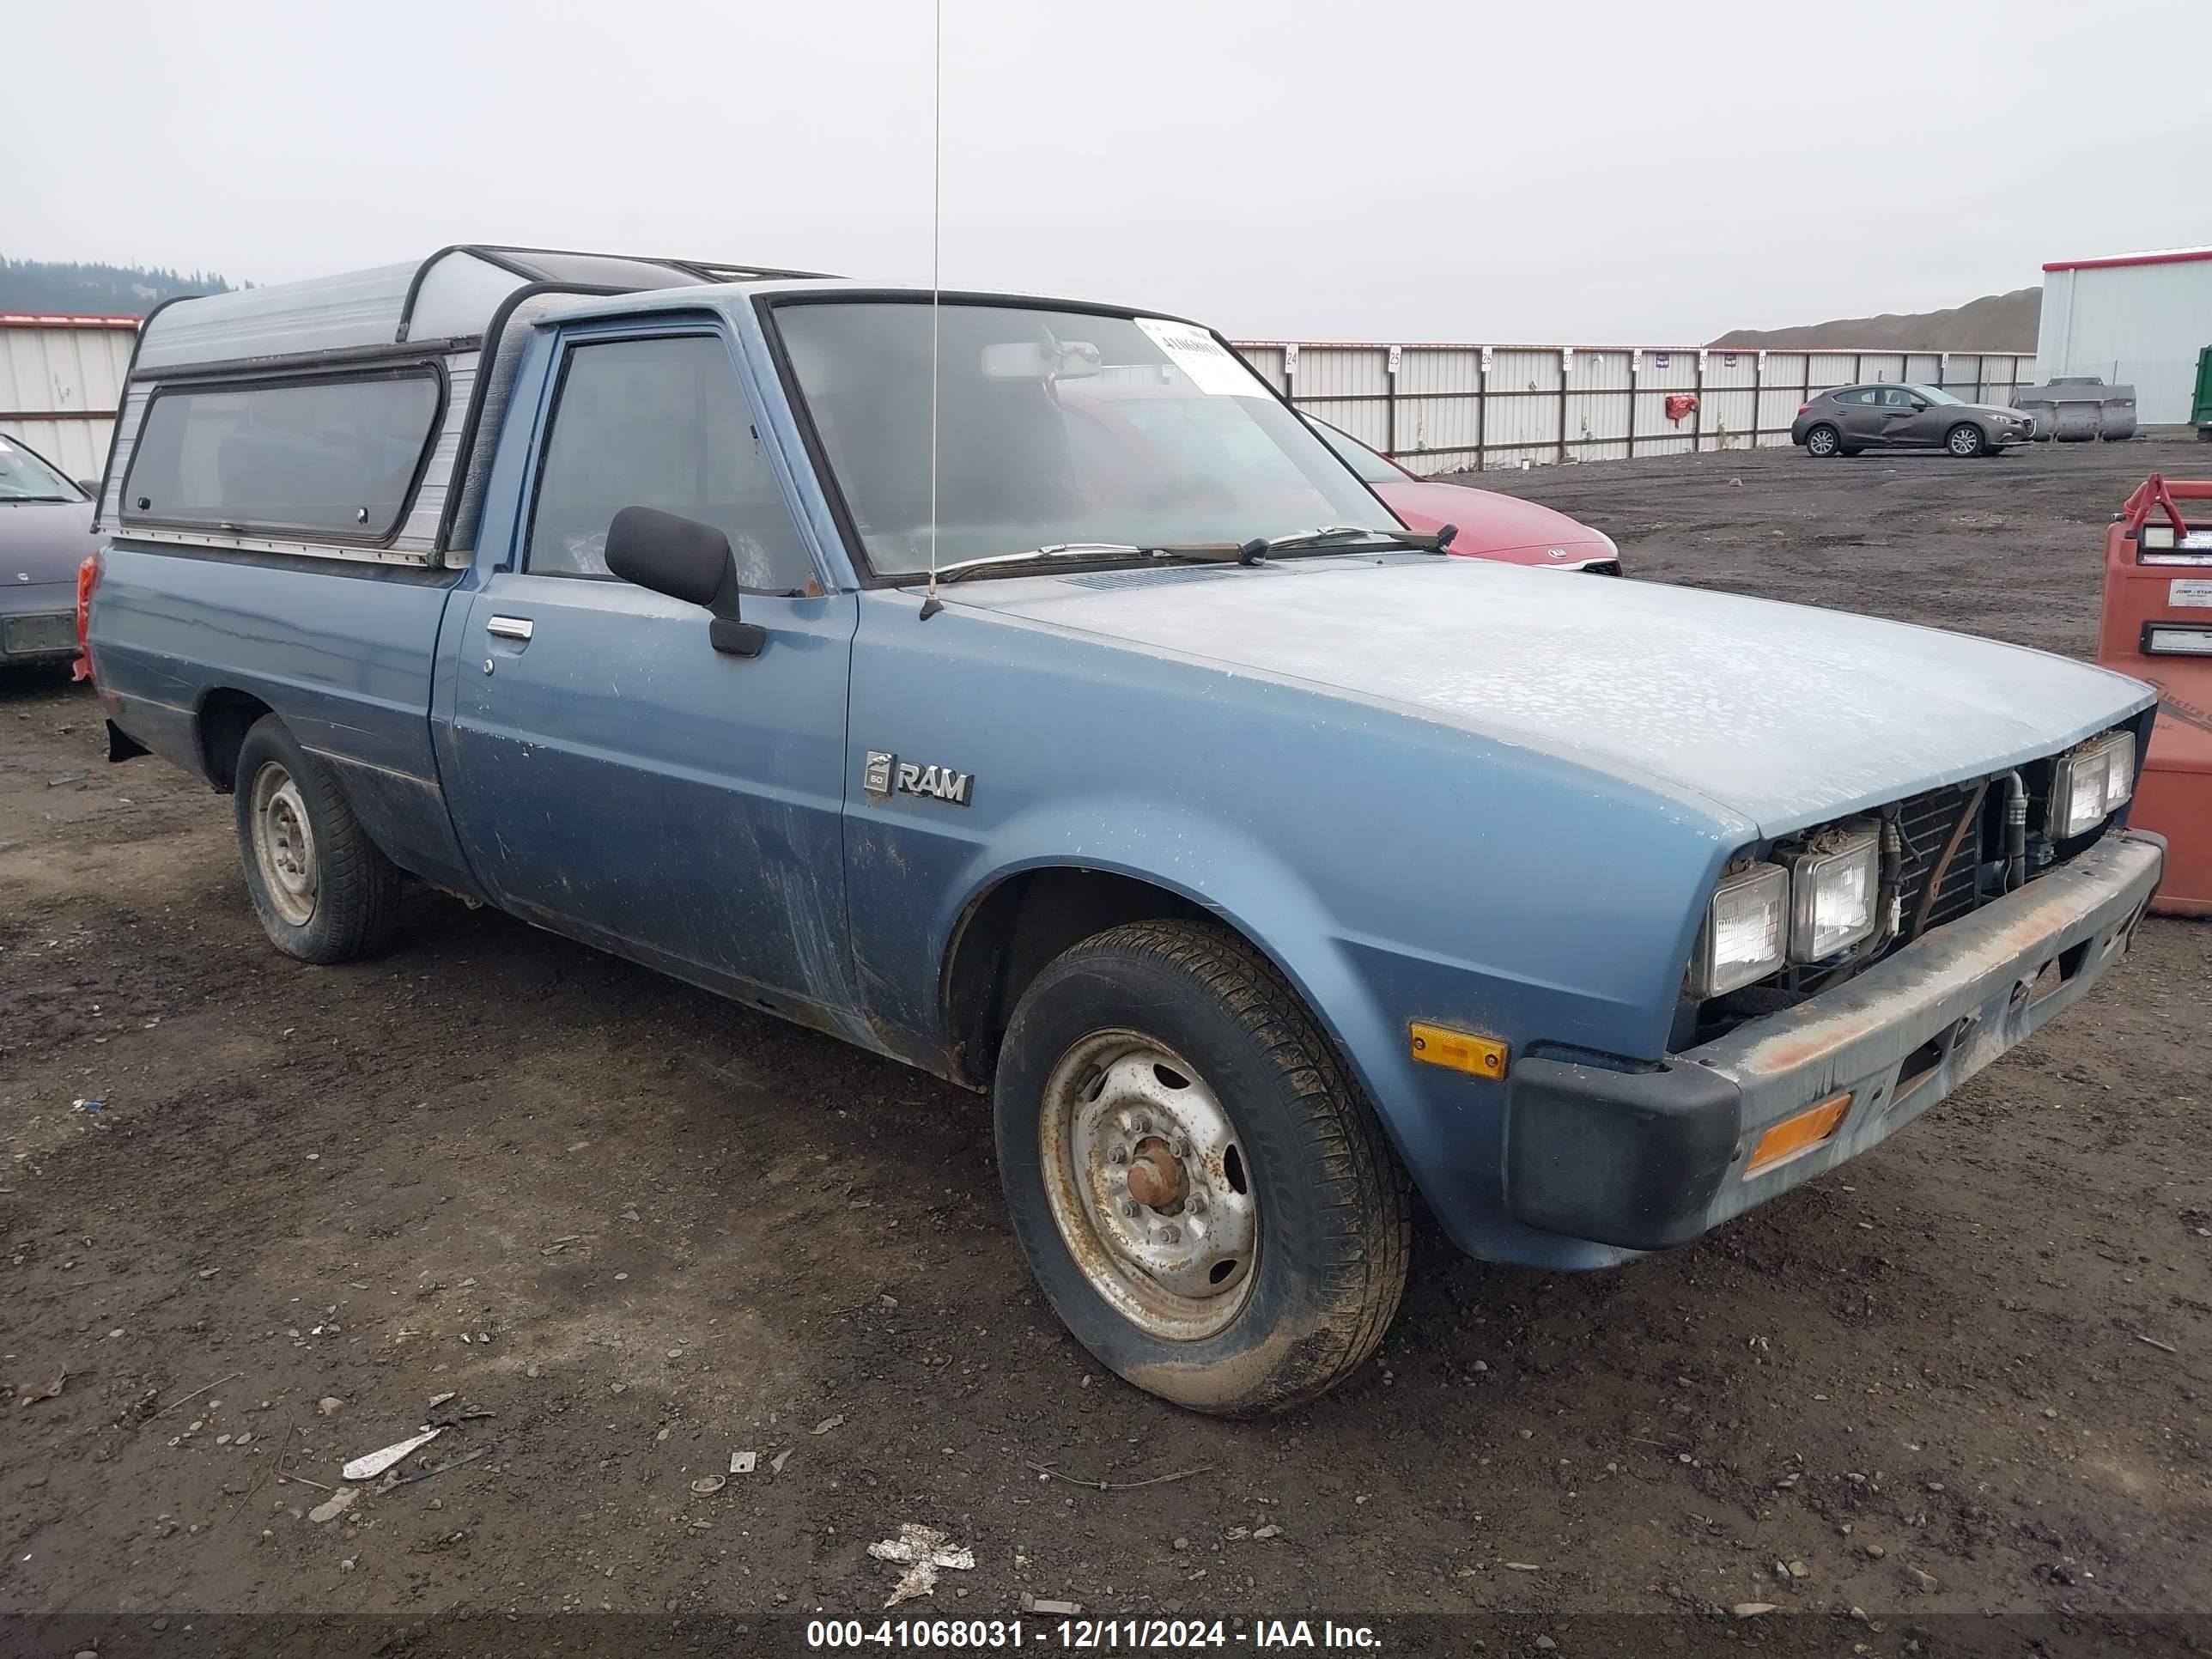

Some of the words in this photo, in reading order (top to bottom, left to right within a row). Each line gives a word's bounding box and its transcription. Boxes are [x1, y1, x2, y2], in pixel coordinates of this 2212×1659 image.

[1286, 352, 1297, 365] 24
[1389, 352, 1401, 365] 25
[1482, 353, 1492, 365] 26
[1564, 353, 1573, 365] 27
[1633, 355, 1642, 365] 28
[1700, 355, 1708, 365] 29
[897, 763, 970, 804] RAM
